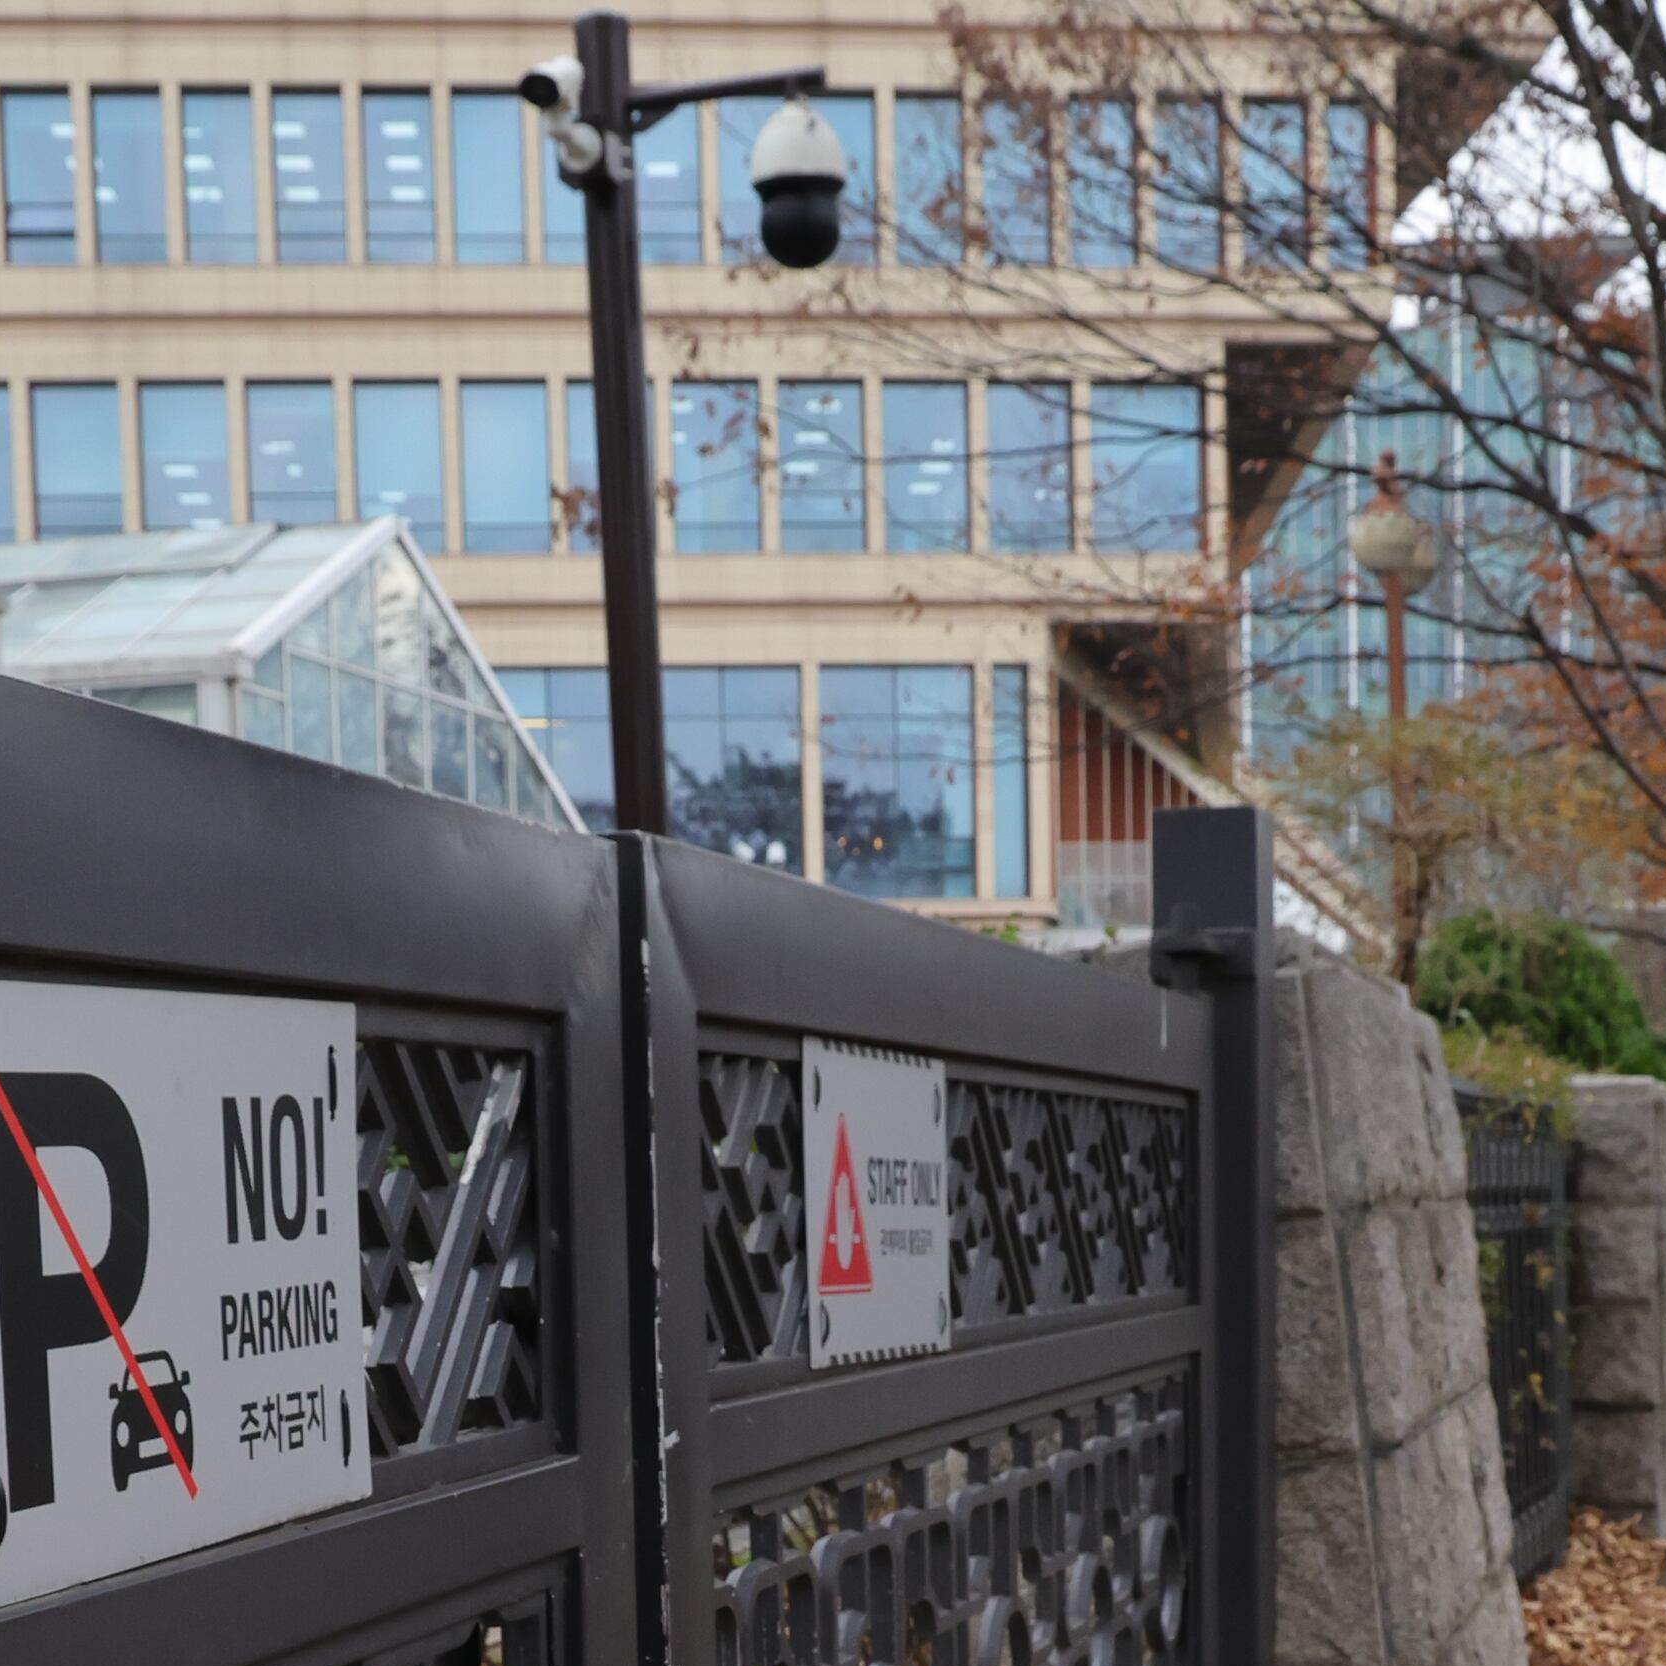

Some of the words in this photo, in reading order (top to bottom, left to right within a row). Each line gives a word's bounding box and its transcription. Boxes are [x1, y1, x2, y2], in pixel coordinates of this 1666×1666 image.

[221, 1094, 329, 1245] NO!
[867, 1156, 908, 1206] STAFF
[220, 1280, 339, 1362] PARKING
[238, 1384, 326, 1460] 주차금지
